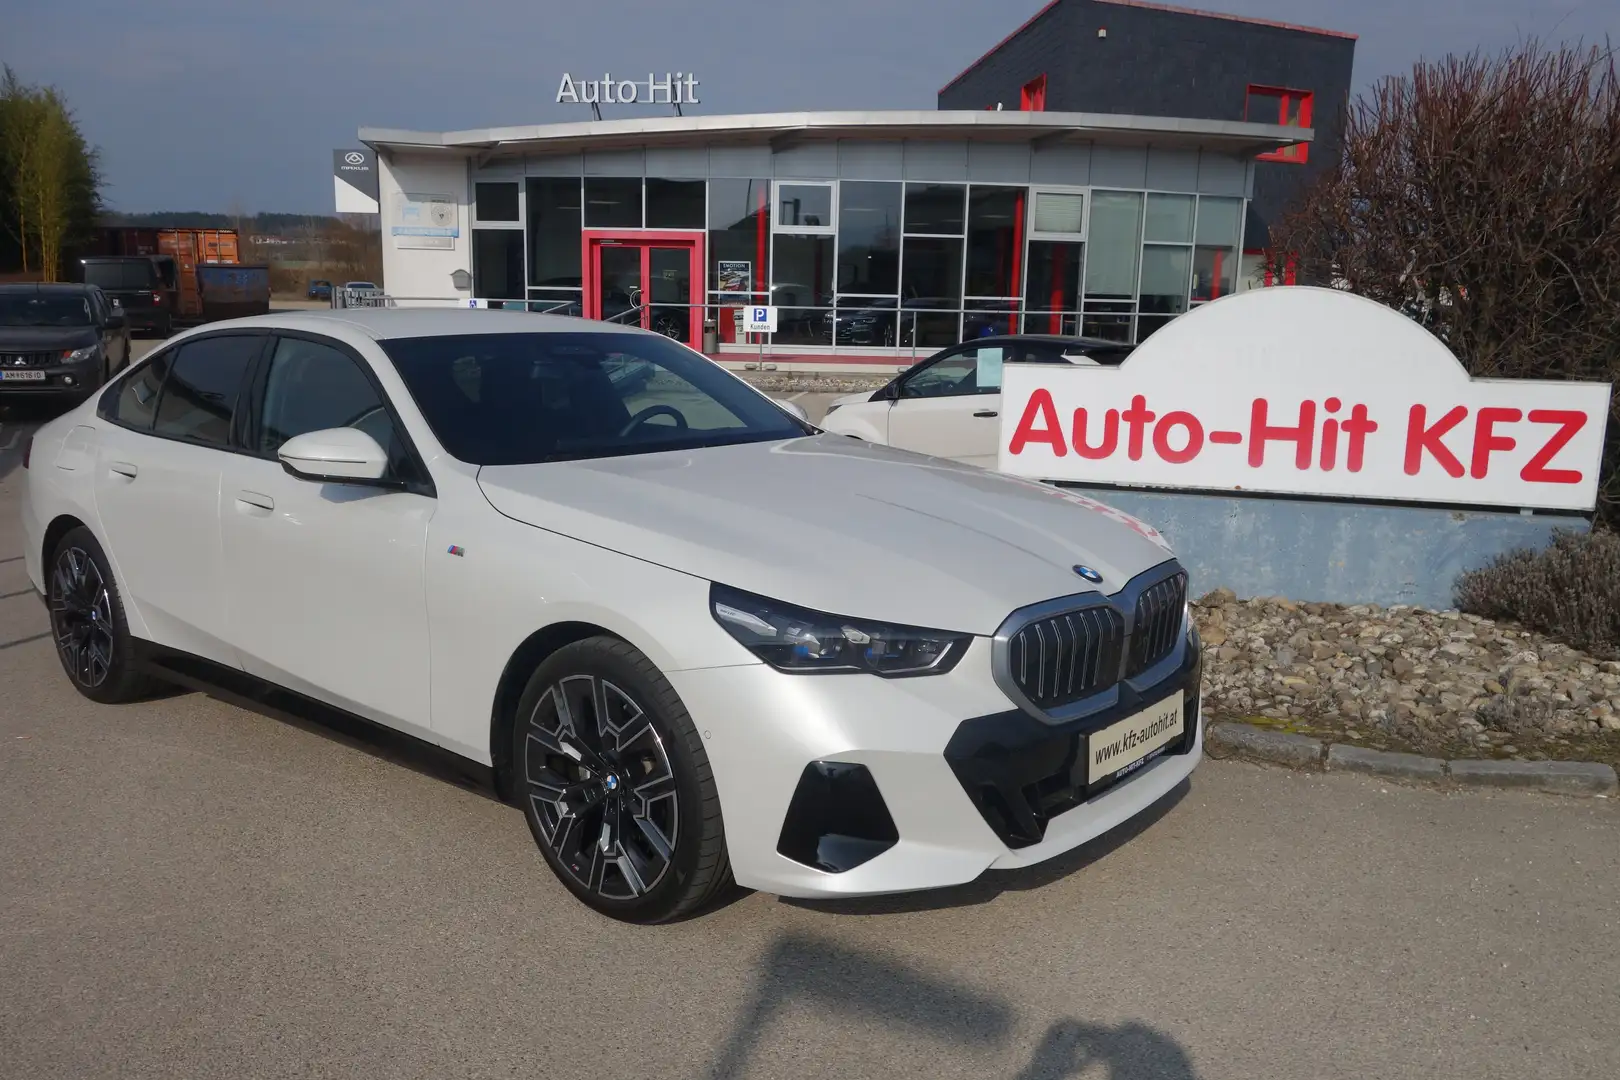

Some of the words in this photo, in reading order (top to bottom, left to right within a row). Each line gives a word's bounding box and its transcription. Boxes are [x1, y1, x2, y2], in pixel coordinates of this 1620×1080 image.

[555, 72, 638, 104] Auto
[648, 71, 701, 104] Hit
[750, 323, 771, 331] Kunden
[756, 309, 765, 322] P
[1008, 387, 1379, 474] Auto-Hit
[1403, 402, 1589, 484] KFZ
[1095, 708, 1178, 765] www.kfz-autohit.at
